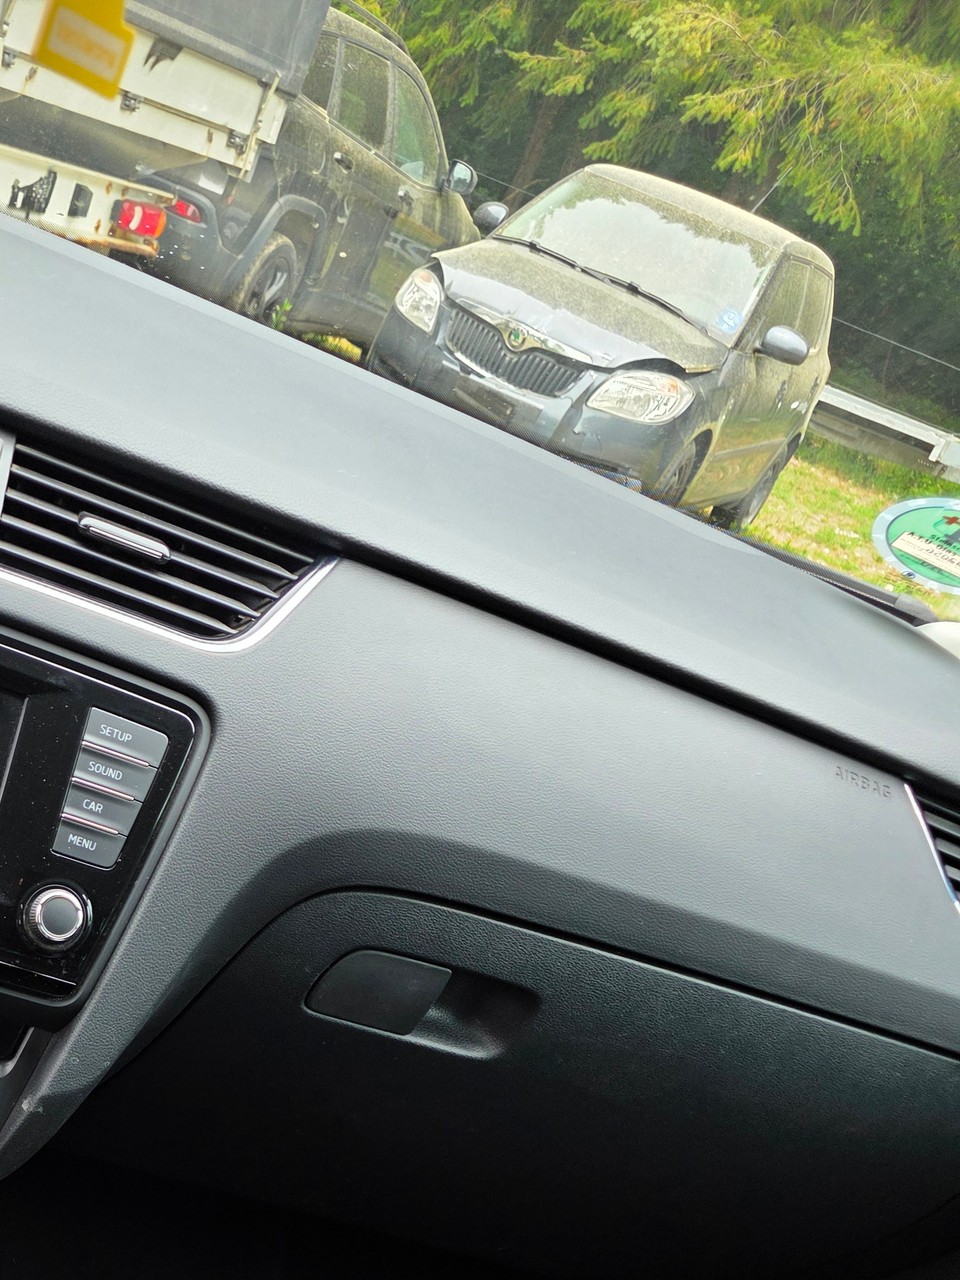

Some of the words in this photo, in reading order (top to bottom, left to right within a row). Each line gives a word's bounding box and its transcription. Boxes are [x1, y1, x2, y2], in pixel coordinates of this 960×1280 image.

[99, 724, 133, 743] SETUP
[88, 761, 123, 781] SOUND
[836, 765, 892, 798] AIRBAG
[82, 799, 103, 814] CAR
[67, 833, 97, 851] MENU
